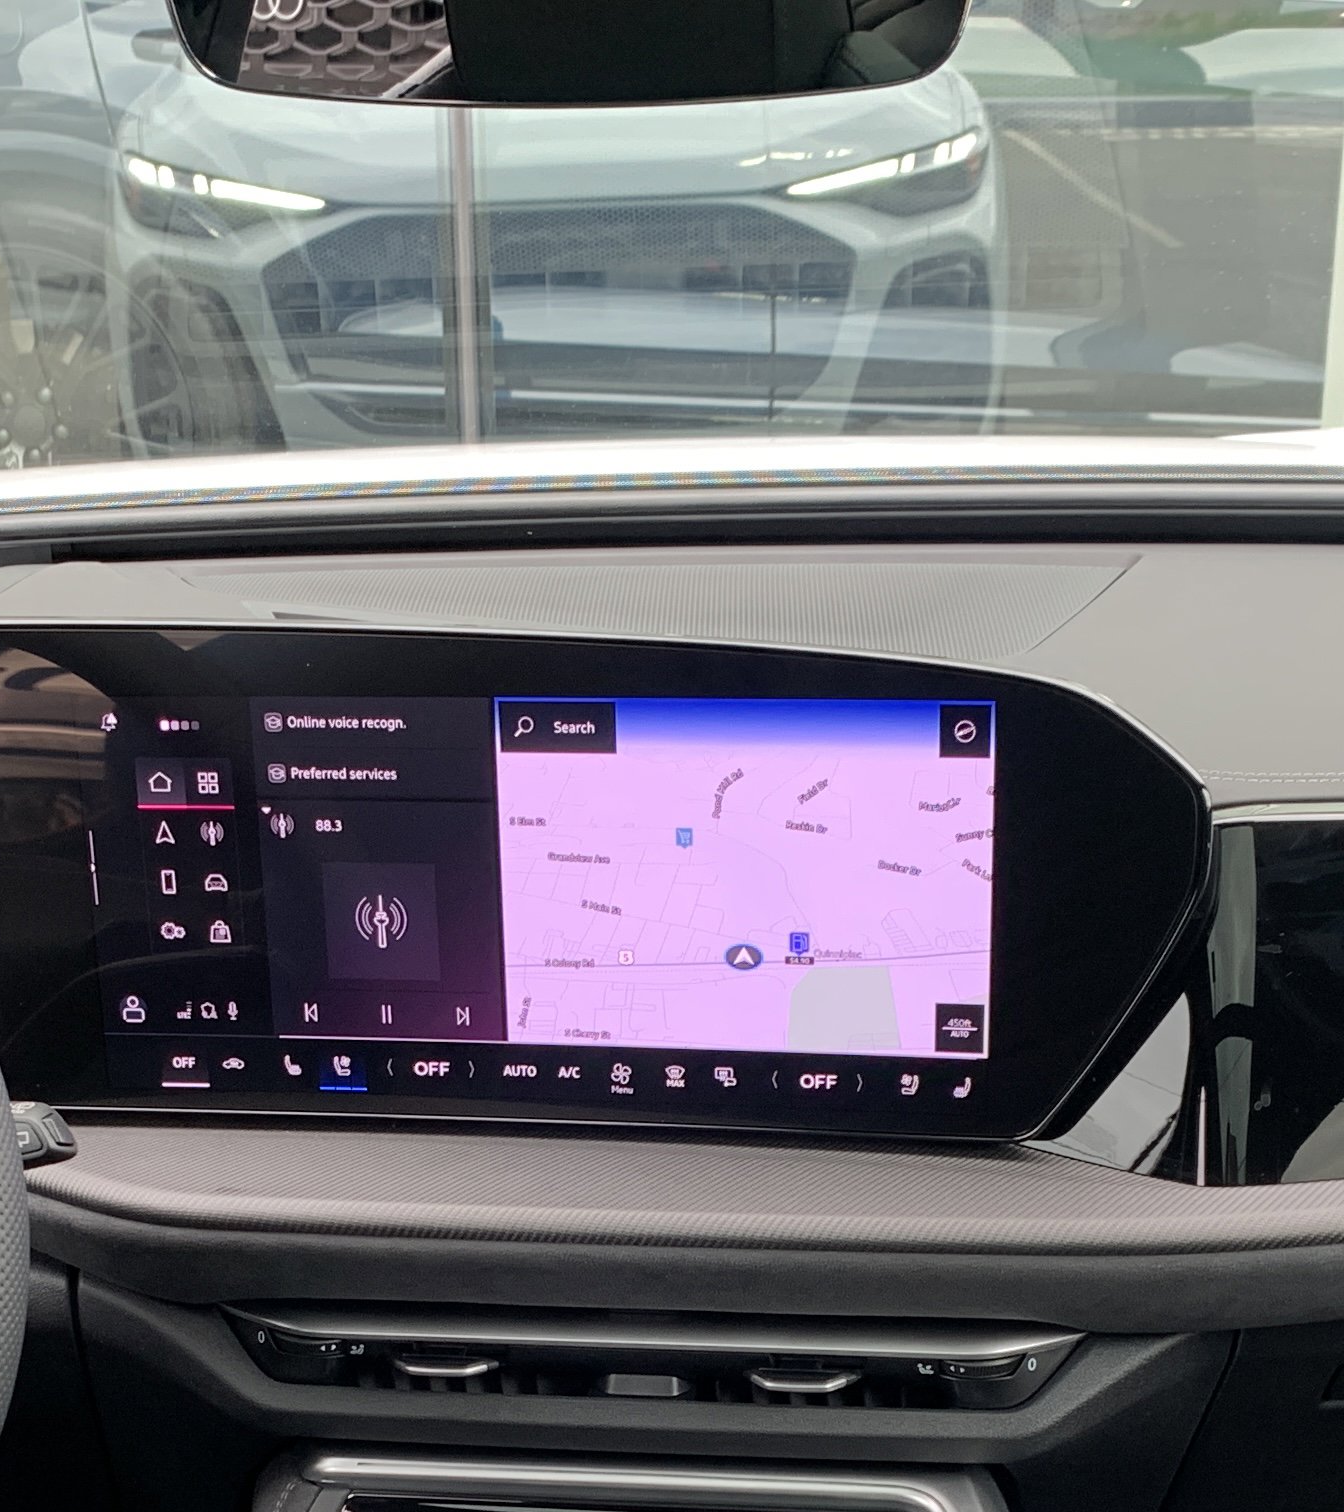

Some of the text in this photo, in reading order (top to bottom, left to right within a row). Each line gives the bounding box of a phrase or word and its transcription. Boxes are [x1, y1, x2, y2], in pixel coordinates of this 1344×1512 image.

[287, 716, 407, 732] Online voice recogn.
[553, 721, 596, 734] Search
[291, 767, 397, 781] Preferred services
[315, 819, 343, 832] 88.3
[623, 954, 629, 963] 5
[950, 1030, 970, 1039] AUTO
[172, 1056, 196, 1070] OFF
[413, 1061, 451, 1077] OFF
[503, 1065, 537, 1078] AUTO
[558, 1066, 581, 1079] A/C
[666, 1079, 685, 1088] MAX
[799, 1074, 838, 1090] OFF
[611, 1085, 634, 1095] Menu
